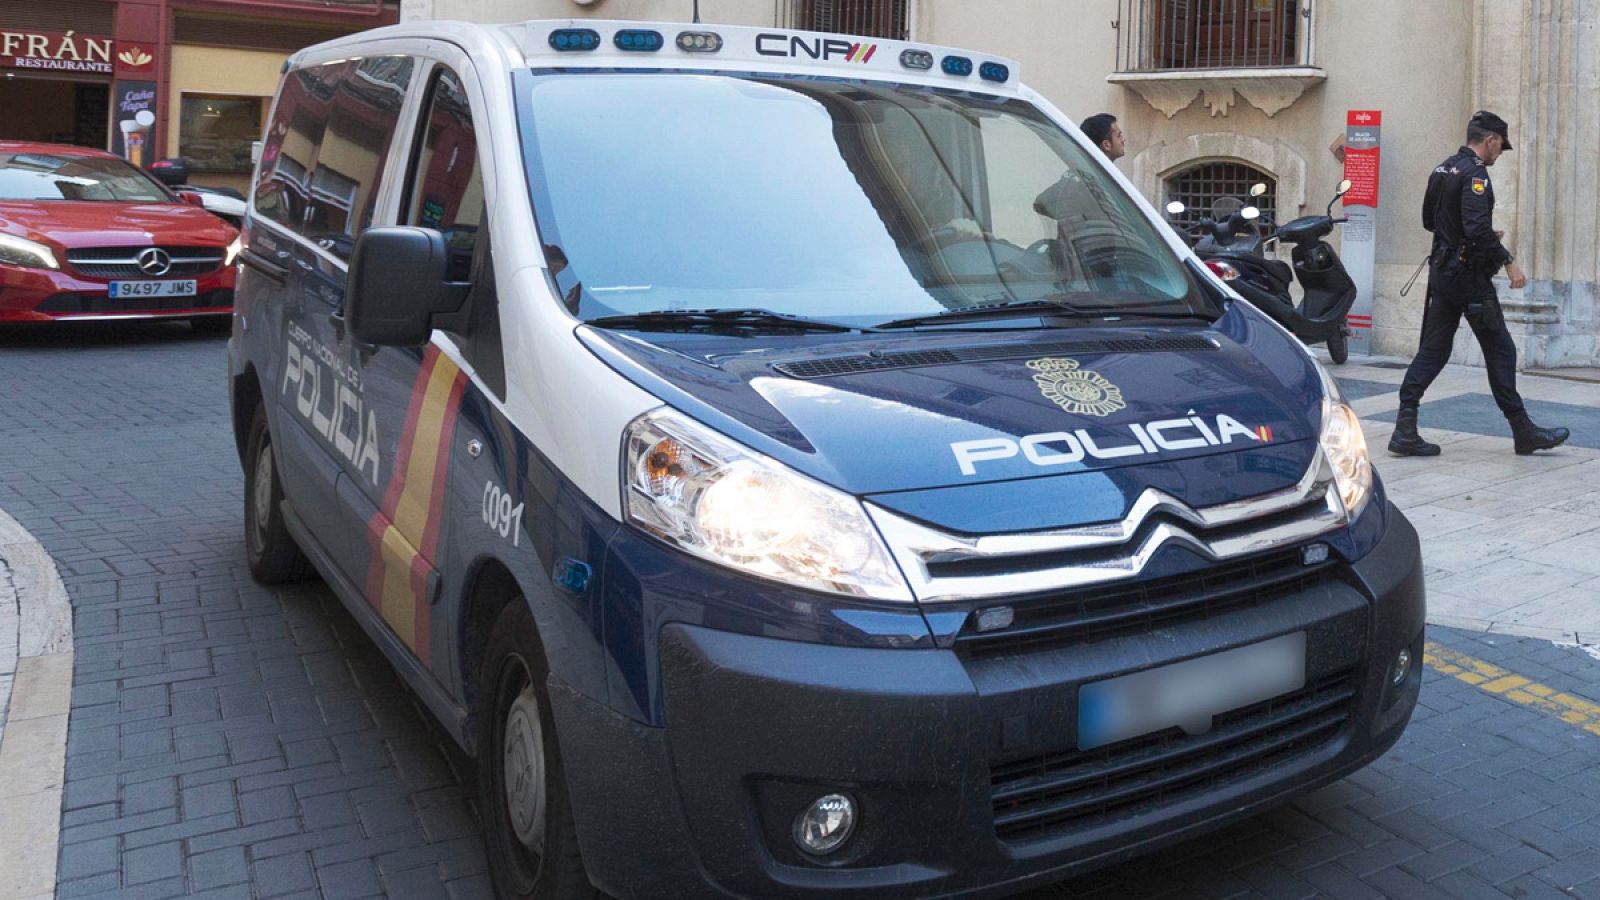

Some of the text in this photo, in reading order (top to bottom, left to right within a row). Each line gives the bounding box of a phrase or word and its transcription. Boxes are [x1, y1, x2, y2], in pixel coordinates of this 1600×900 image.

[1, 30, 113, 62] FRÁN
[756, 33, 852, 60] CNP
[15, 57, 112, 72] RESTAURANTE
[122, 282, 192, 295] 9497 JMS
[950, 408, 1259, 476] POLICÍA
